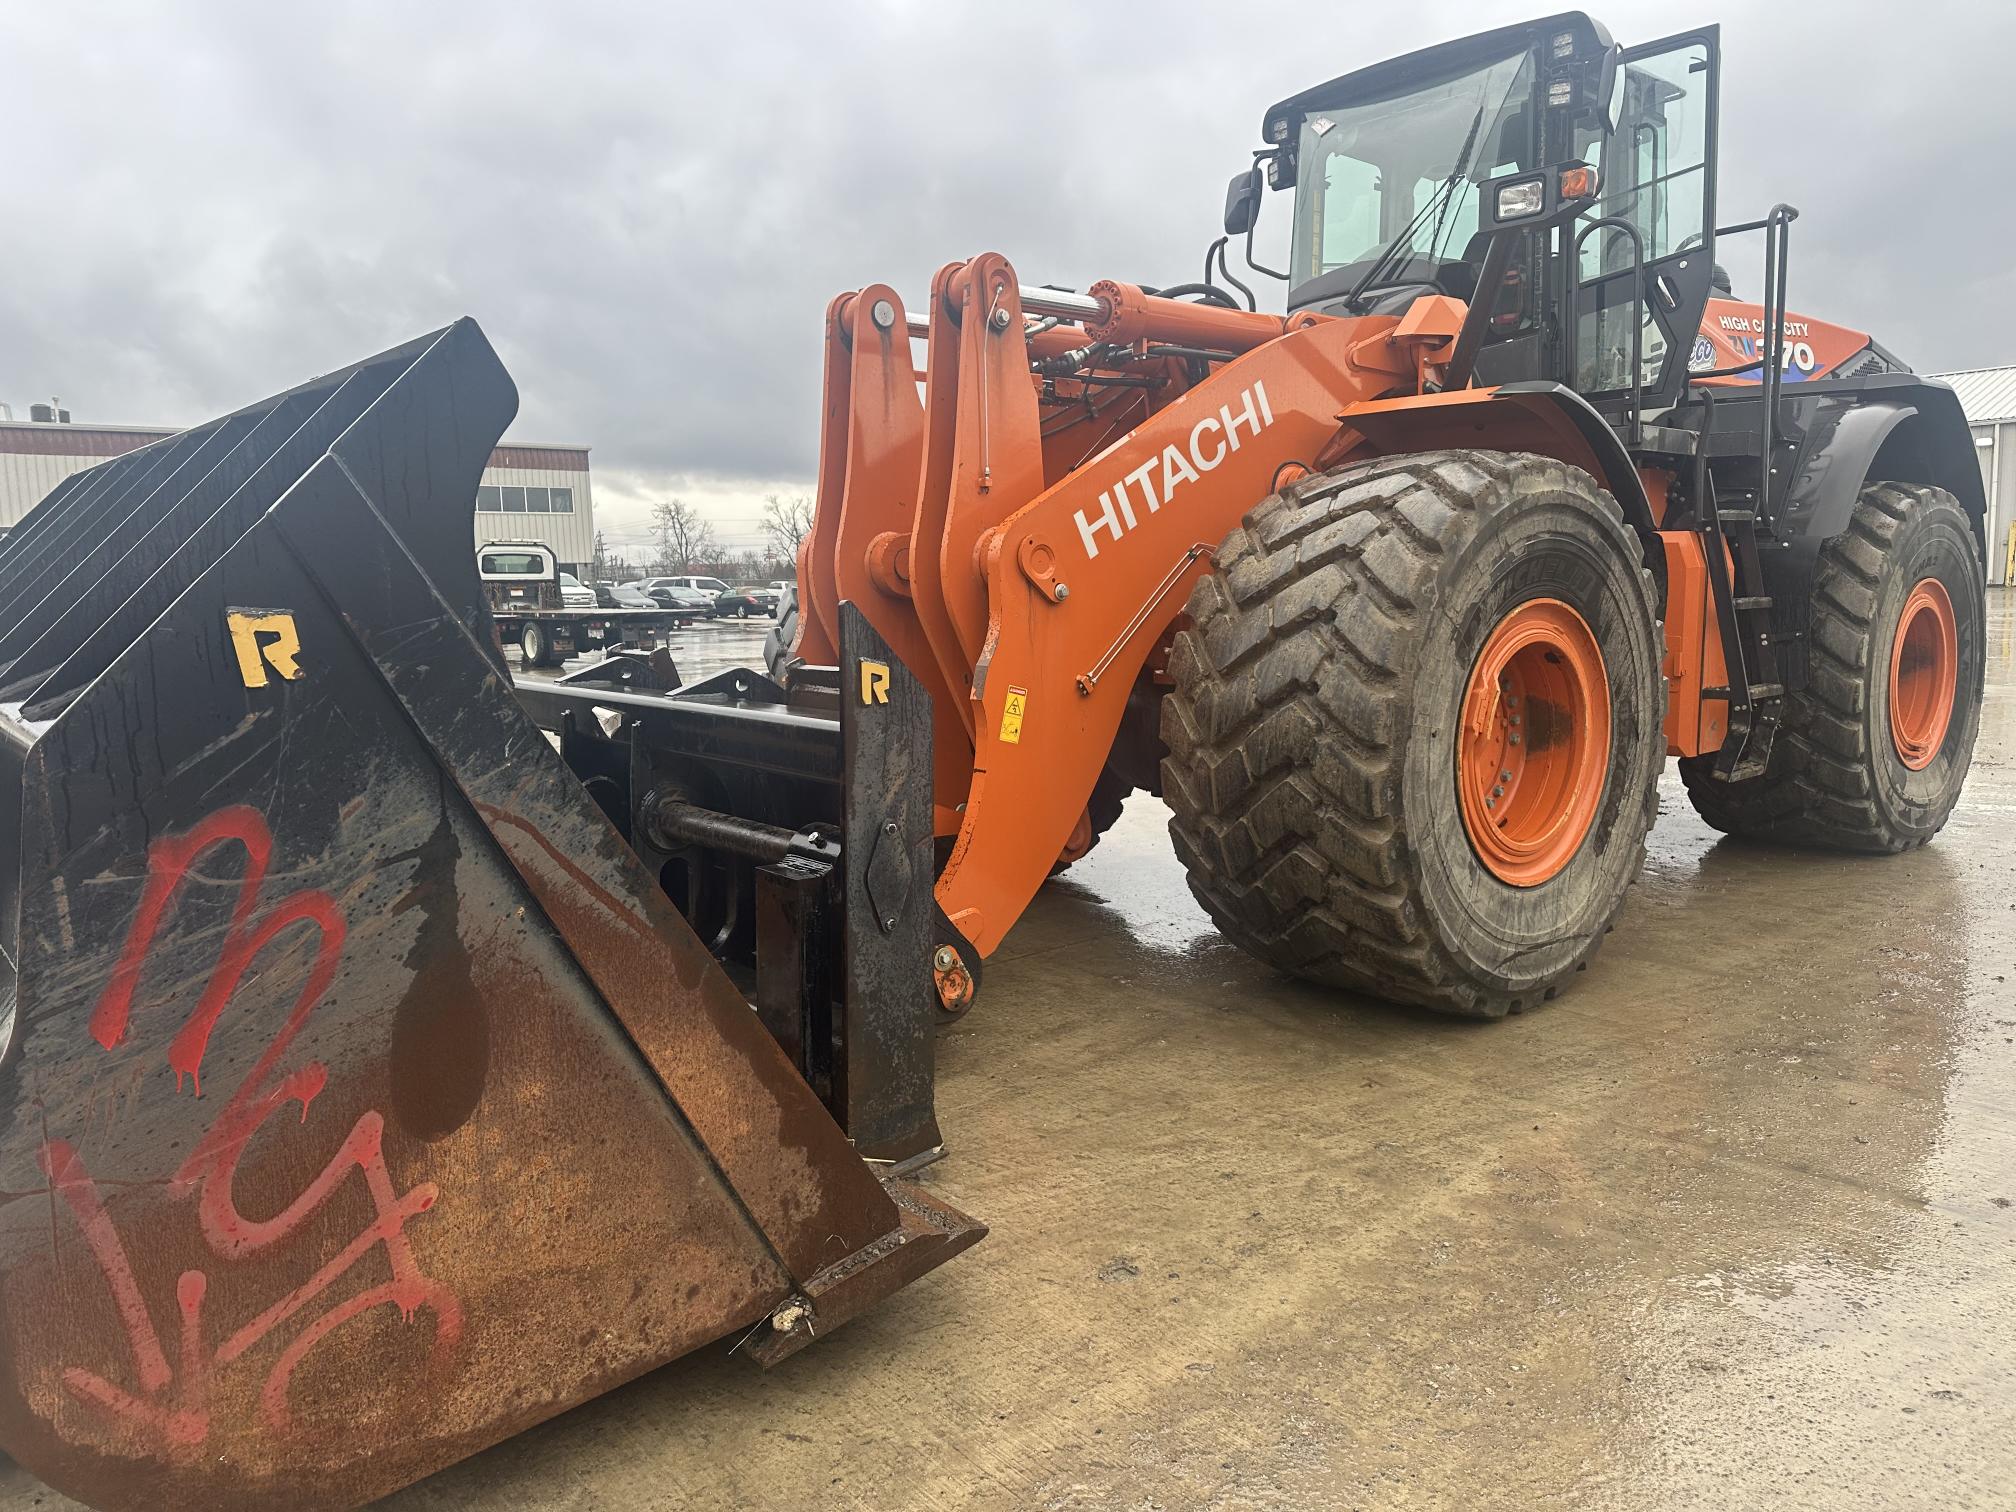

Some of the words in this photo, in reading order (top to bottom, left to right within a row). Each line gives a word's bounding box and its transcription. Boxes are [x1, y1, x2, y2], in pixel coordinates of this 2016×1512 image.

[1719, 315, 1752, 332] HIGH
[1752, 319, 1809, 337] CCITY
[1073, 379, 1274, 560] HITACHI
[226, 611, 301, 688] R
[859, 661, 890, 704] R
